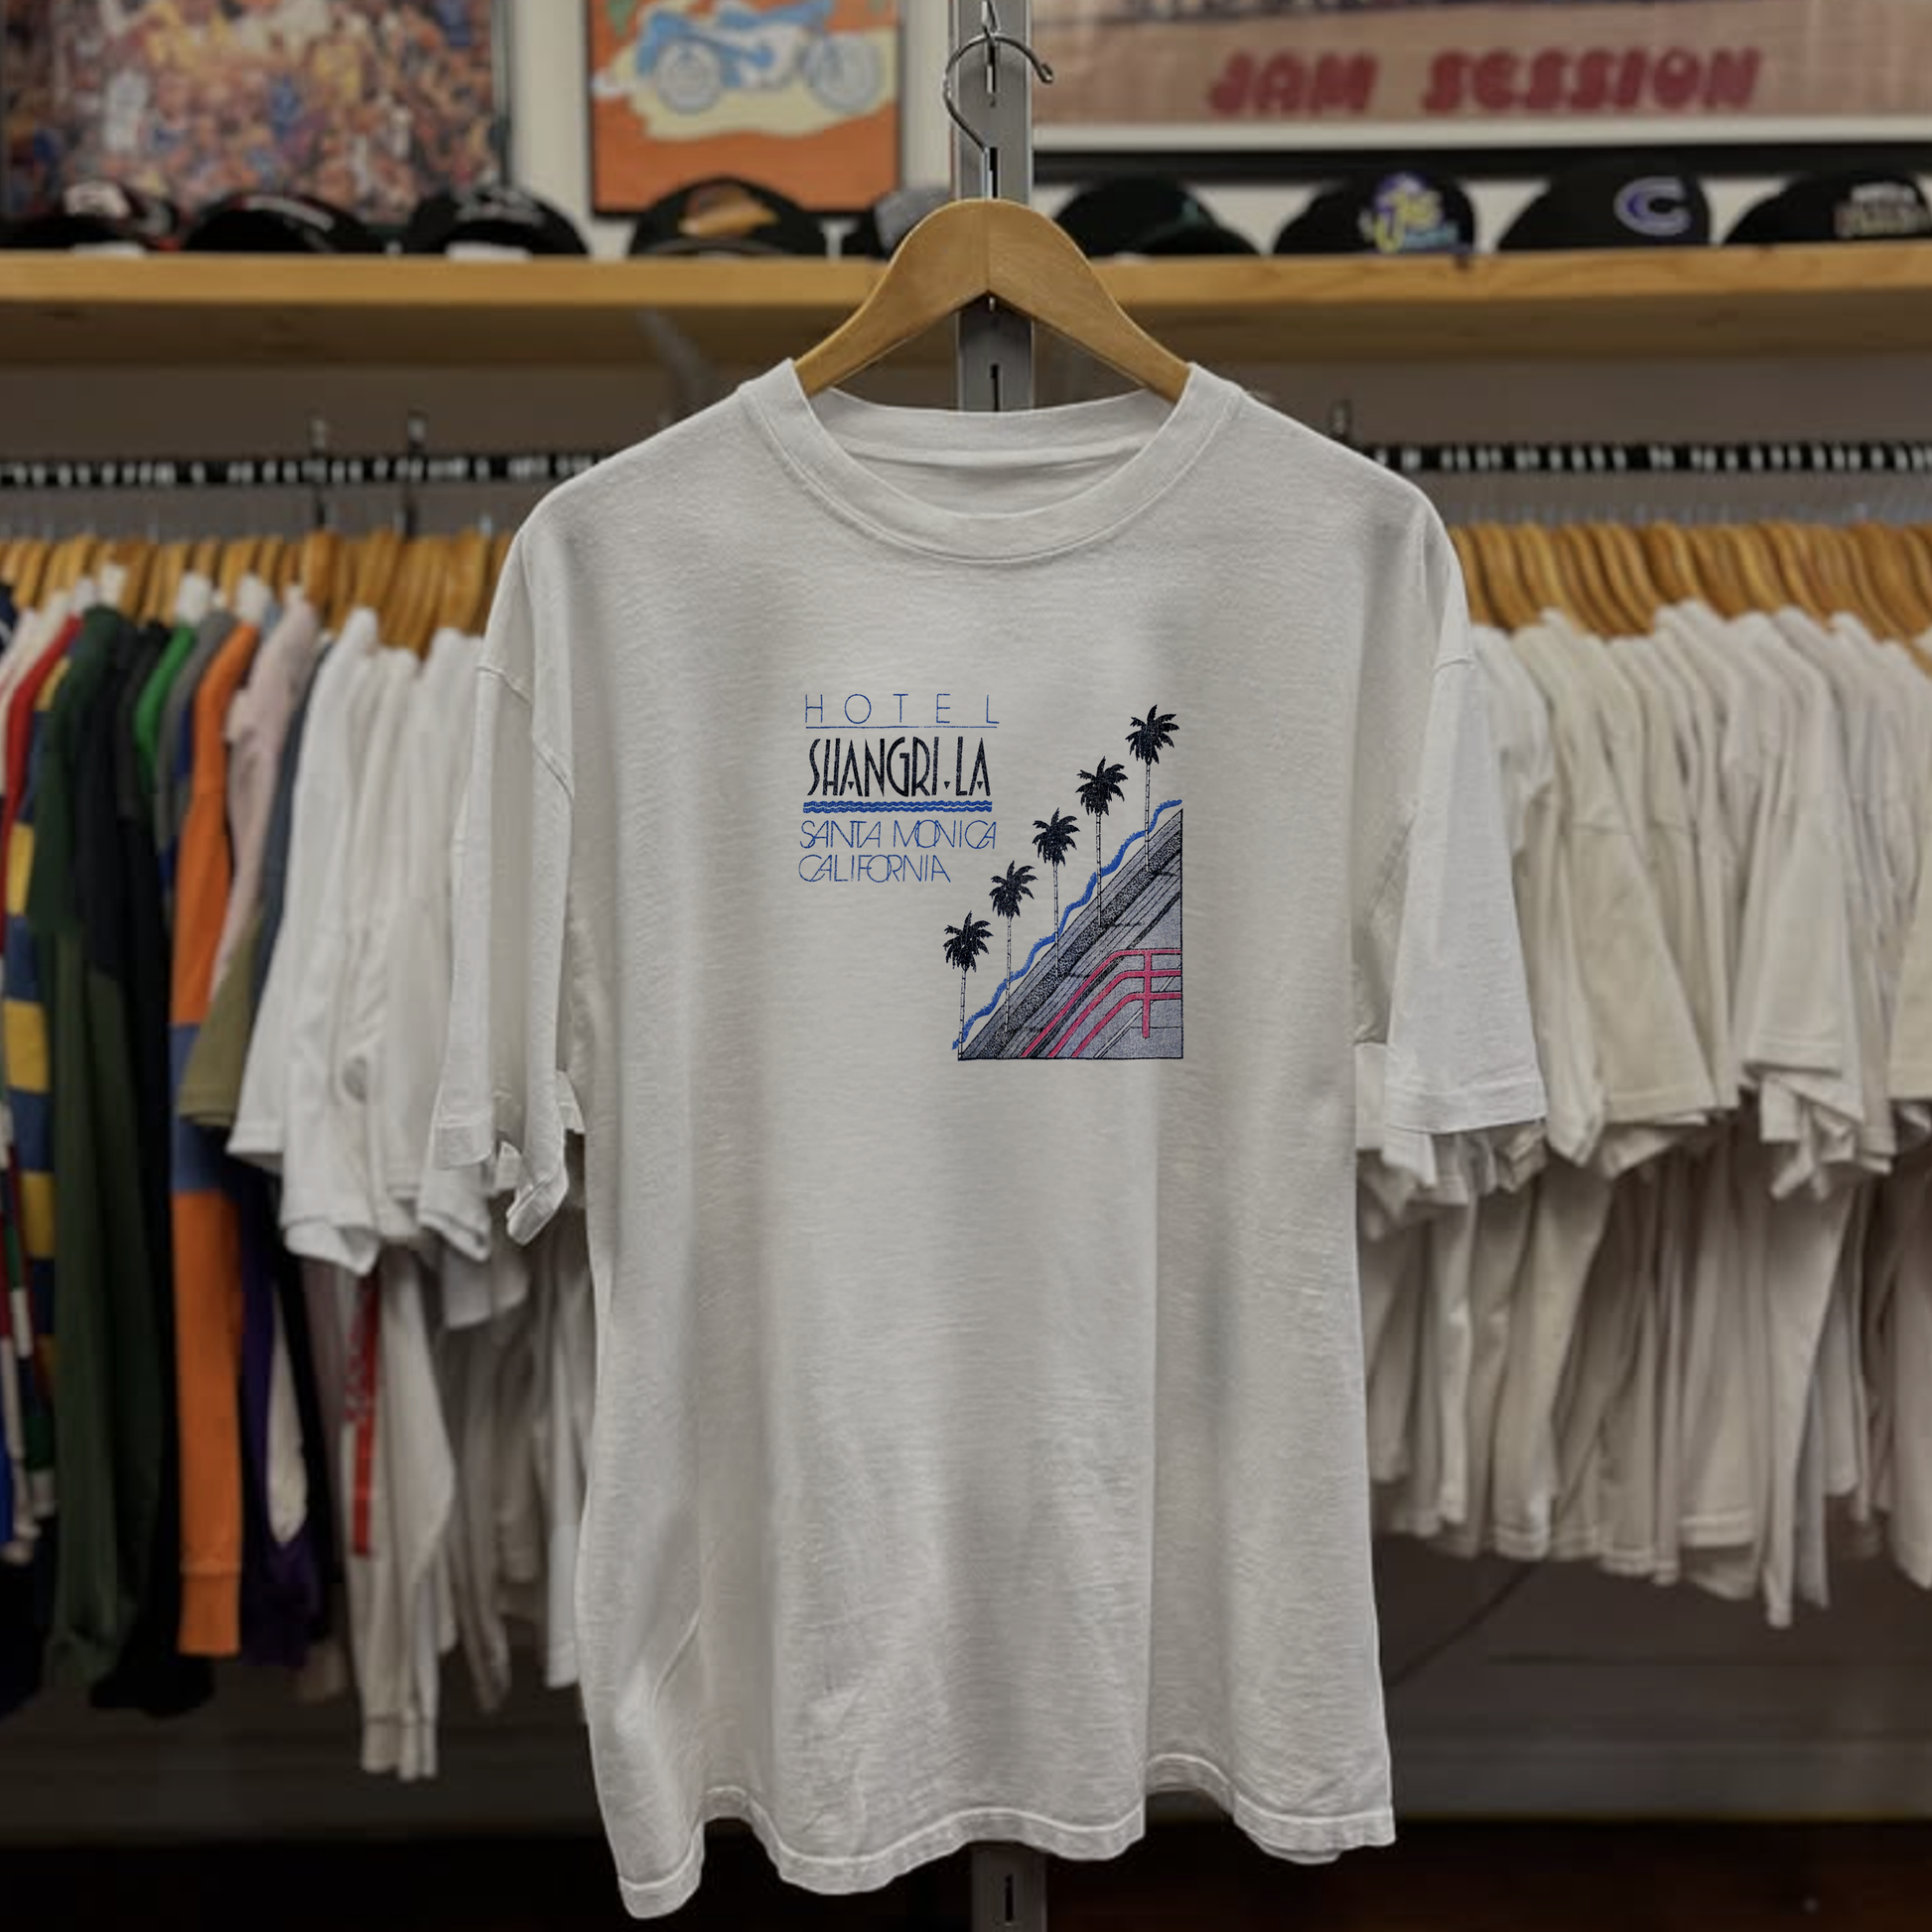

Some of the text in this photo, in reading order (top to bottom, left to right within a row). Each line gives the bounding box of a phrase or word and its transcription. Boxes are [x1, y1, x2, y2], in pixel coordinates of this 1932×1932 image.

[1208, 47, 1759, 117] JAM SESSION
[804, 693, 1000, 725] HOTEL
[799, 819, 997, 850] SANTA MONICA
[798, 854, 951, 883] CALIFORNIA
